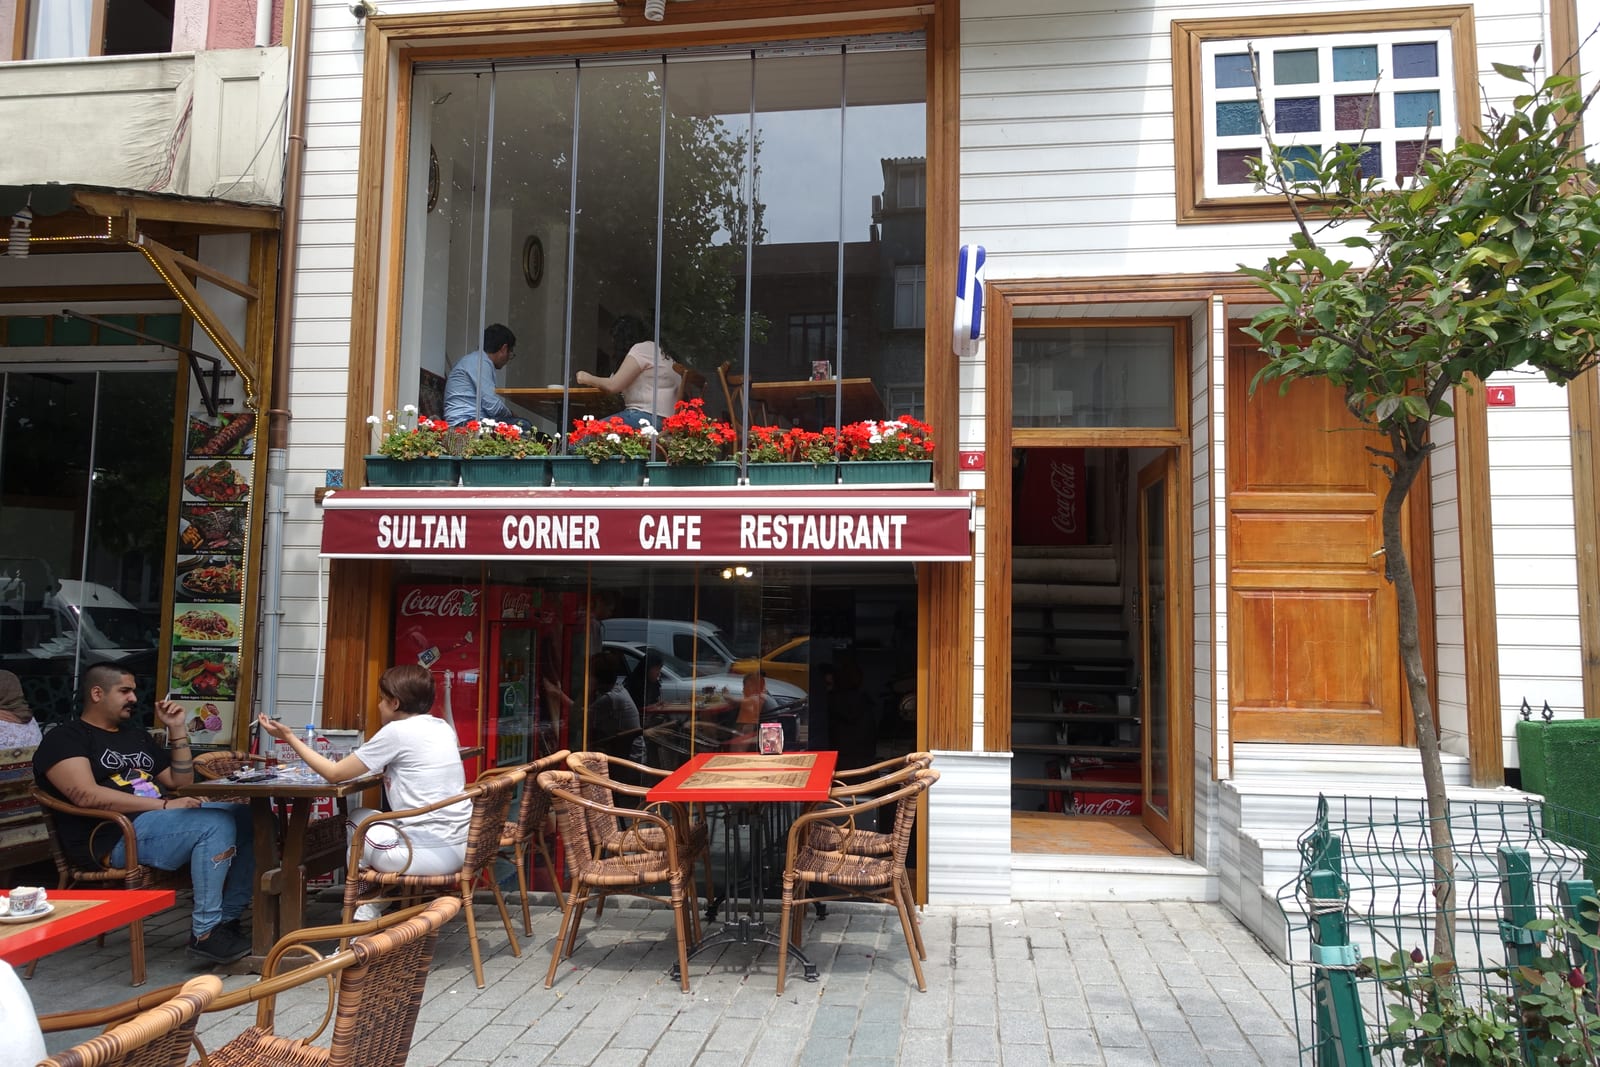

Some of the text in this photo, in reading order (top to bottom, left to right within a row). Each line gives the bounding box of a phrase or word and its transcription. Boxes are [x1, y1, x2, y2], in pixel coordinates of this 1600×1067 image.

[1497, 390, 1505, 401] 4
[967, 455, 979, 465] 4A
[377, 514, 908, 550] SULTAN CORNER CAFE RESTAURANT
